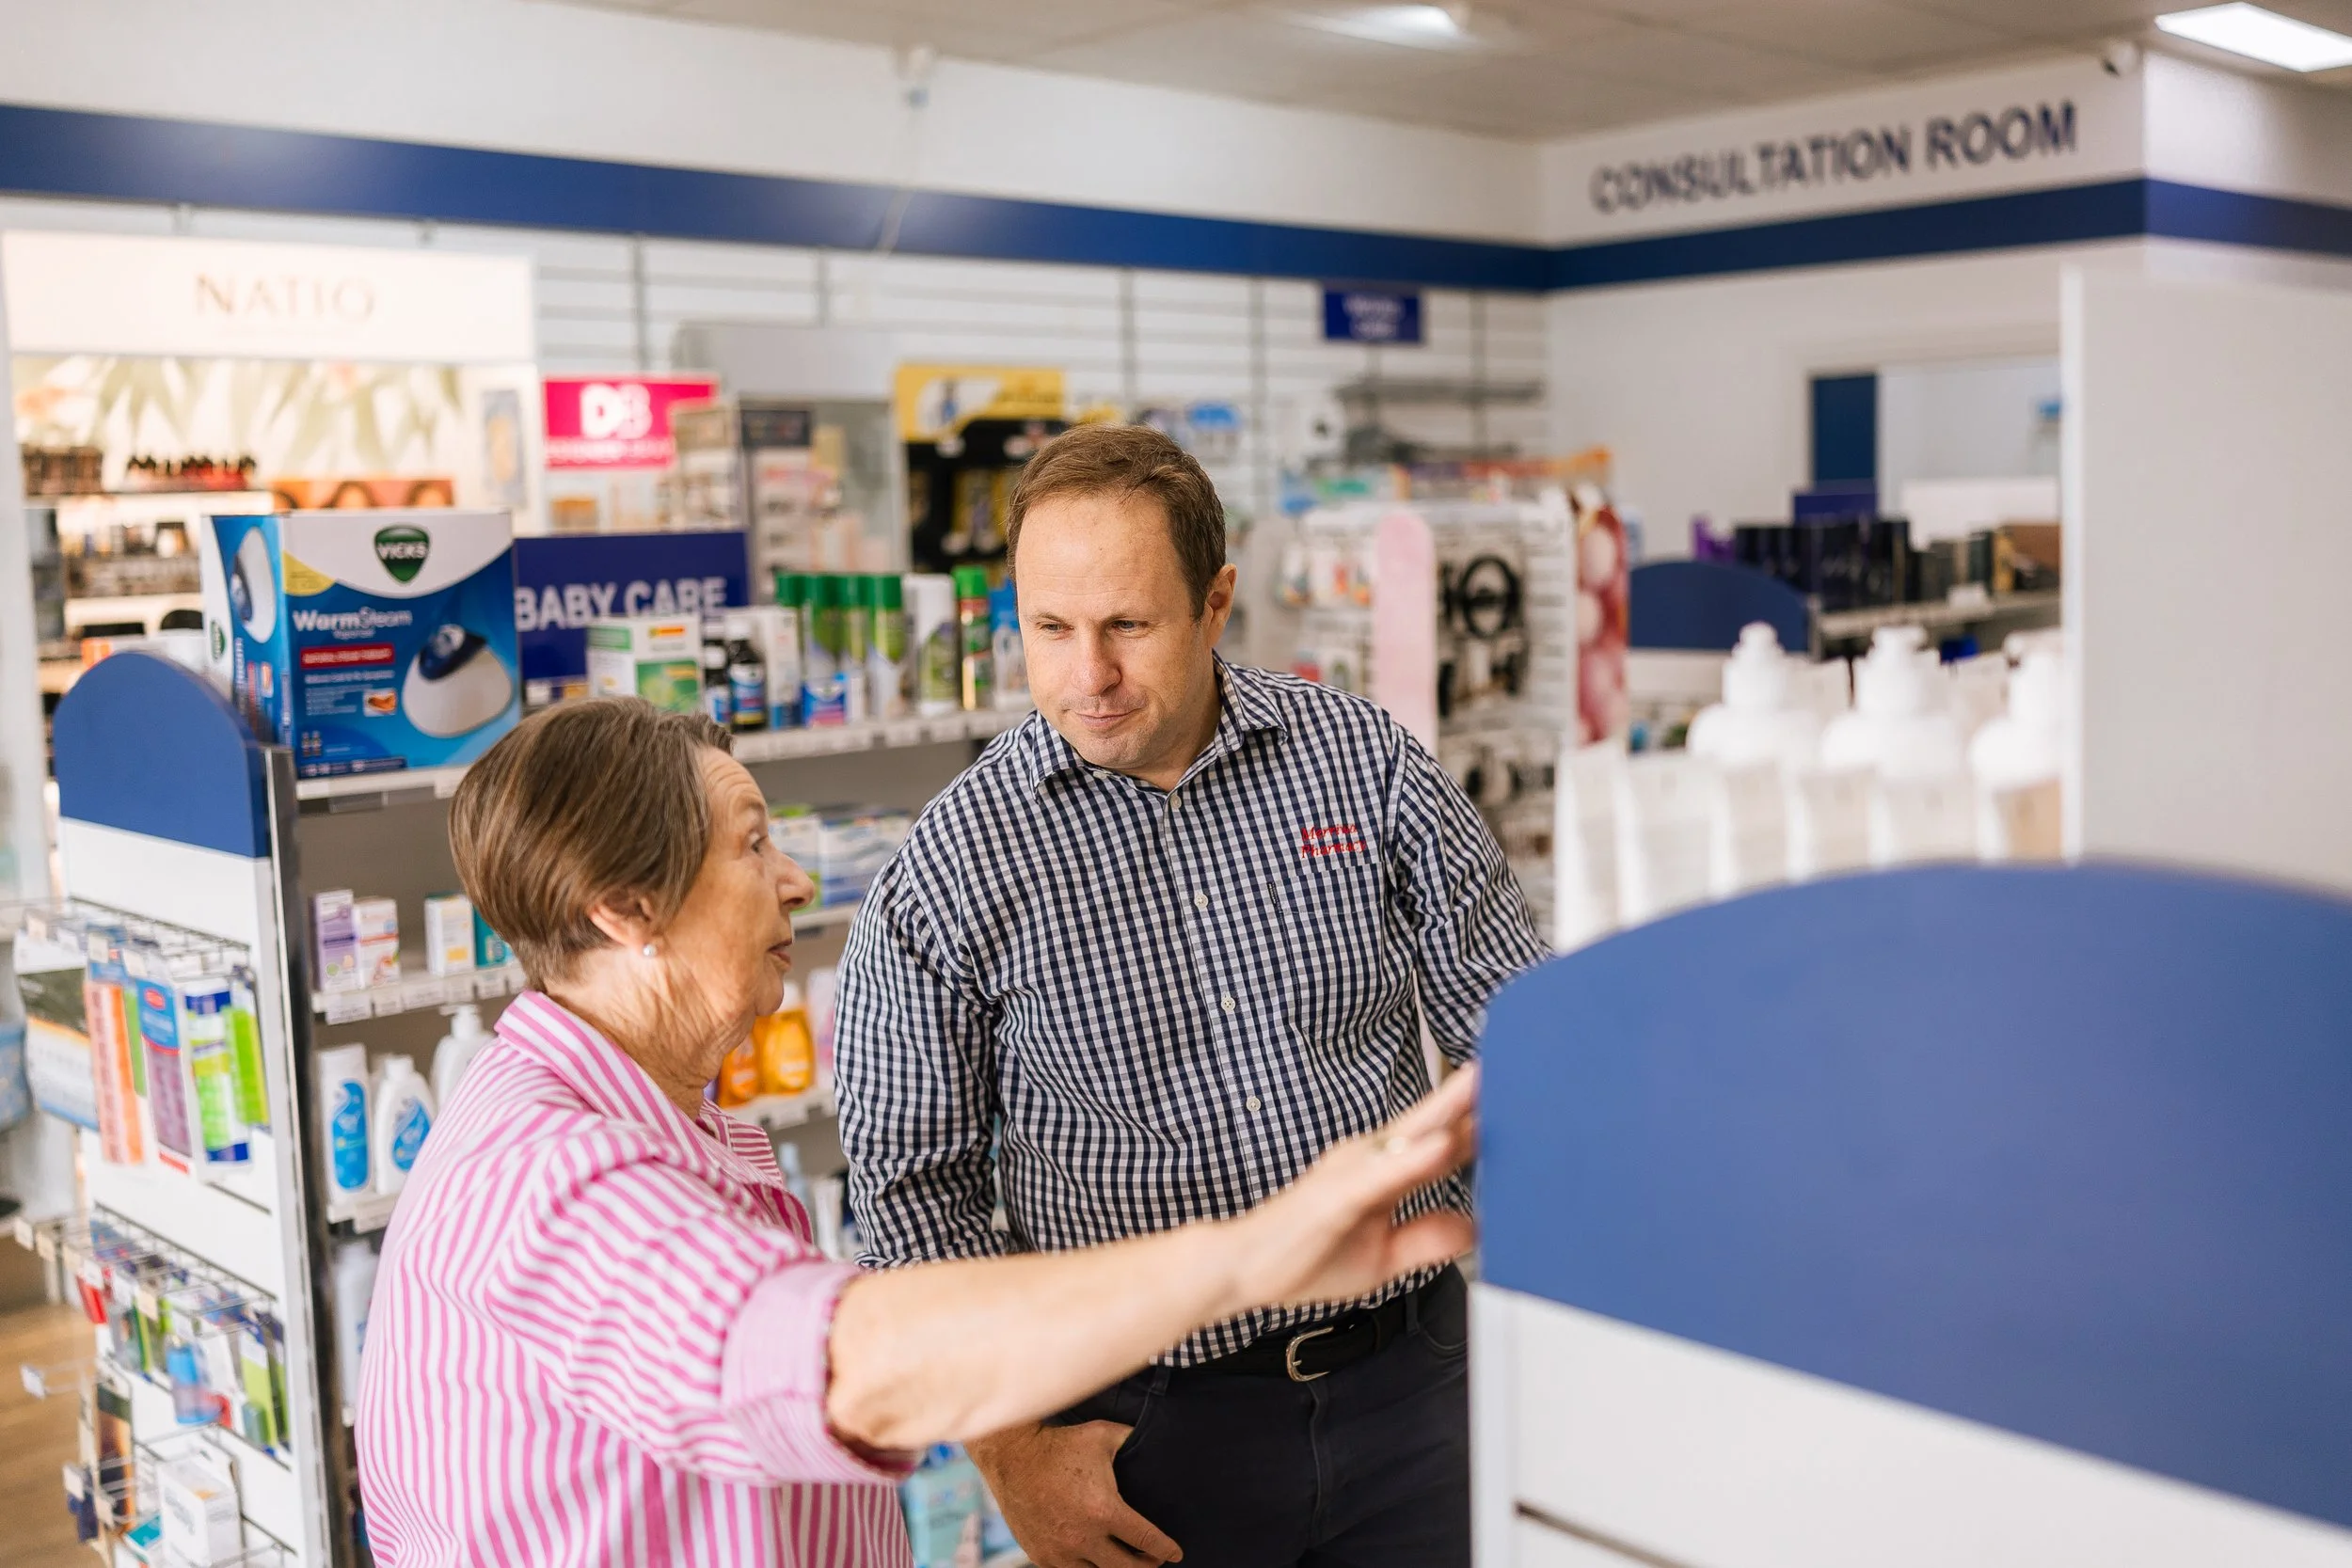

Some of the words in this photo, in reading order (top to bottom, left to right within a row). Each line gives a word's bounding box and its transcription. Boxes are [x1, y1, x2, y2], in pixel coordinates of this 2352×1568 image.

[1590, 126, 1911, 214] CONSULTATION
[1925, 99, 2079, 172] ROOM
[195, 274, 374, 322] NATIO
[375, 542, 429, 561] VICKS
[515, 581, 617, 631] BABY
[624, 575, 728, 618] CARE
[1301, 840, 1367, 858] Pharmacy
